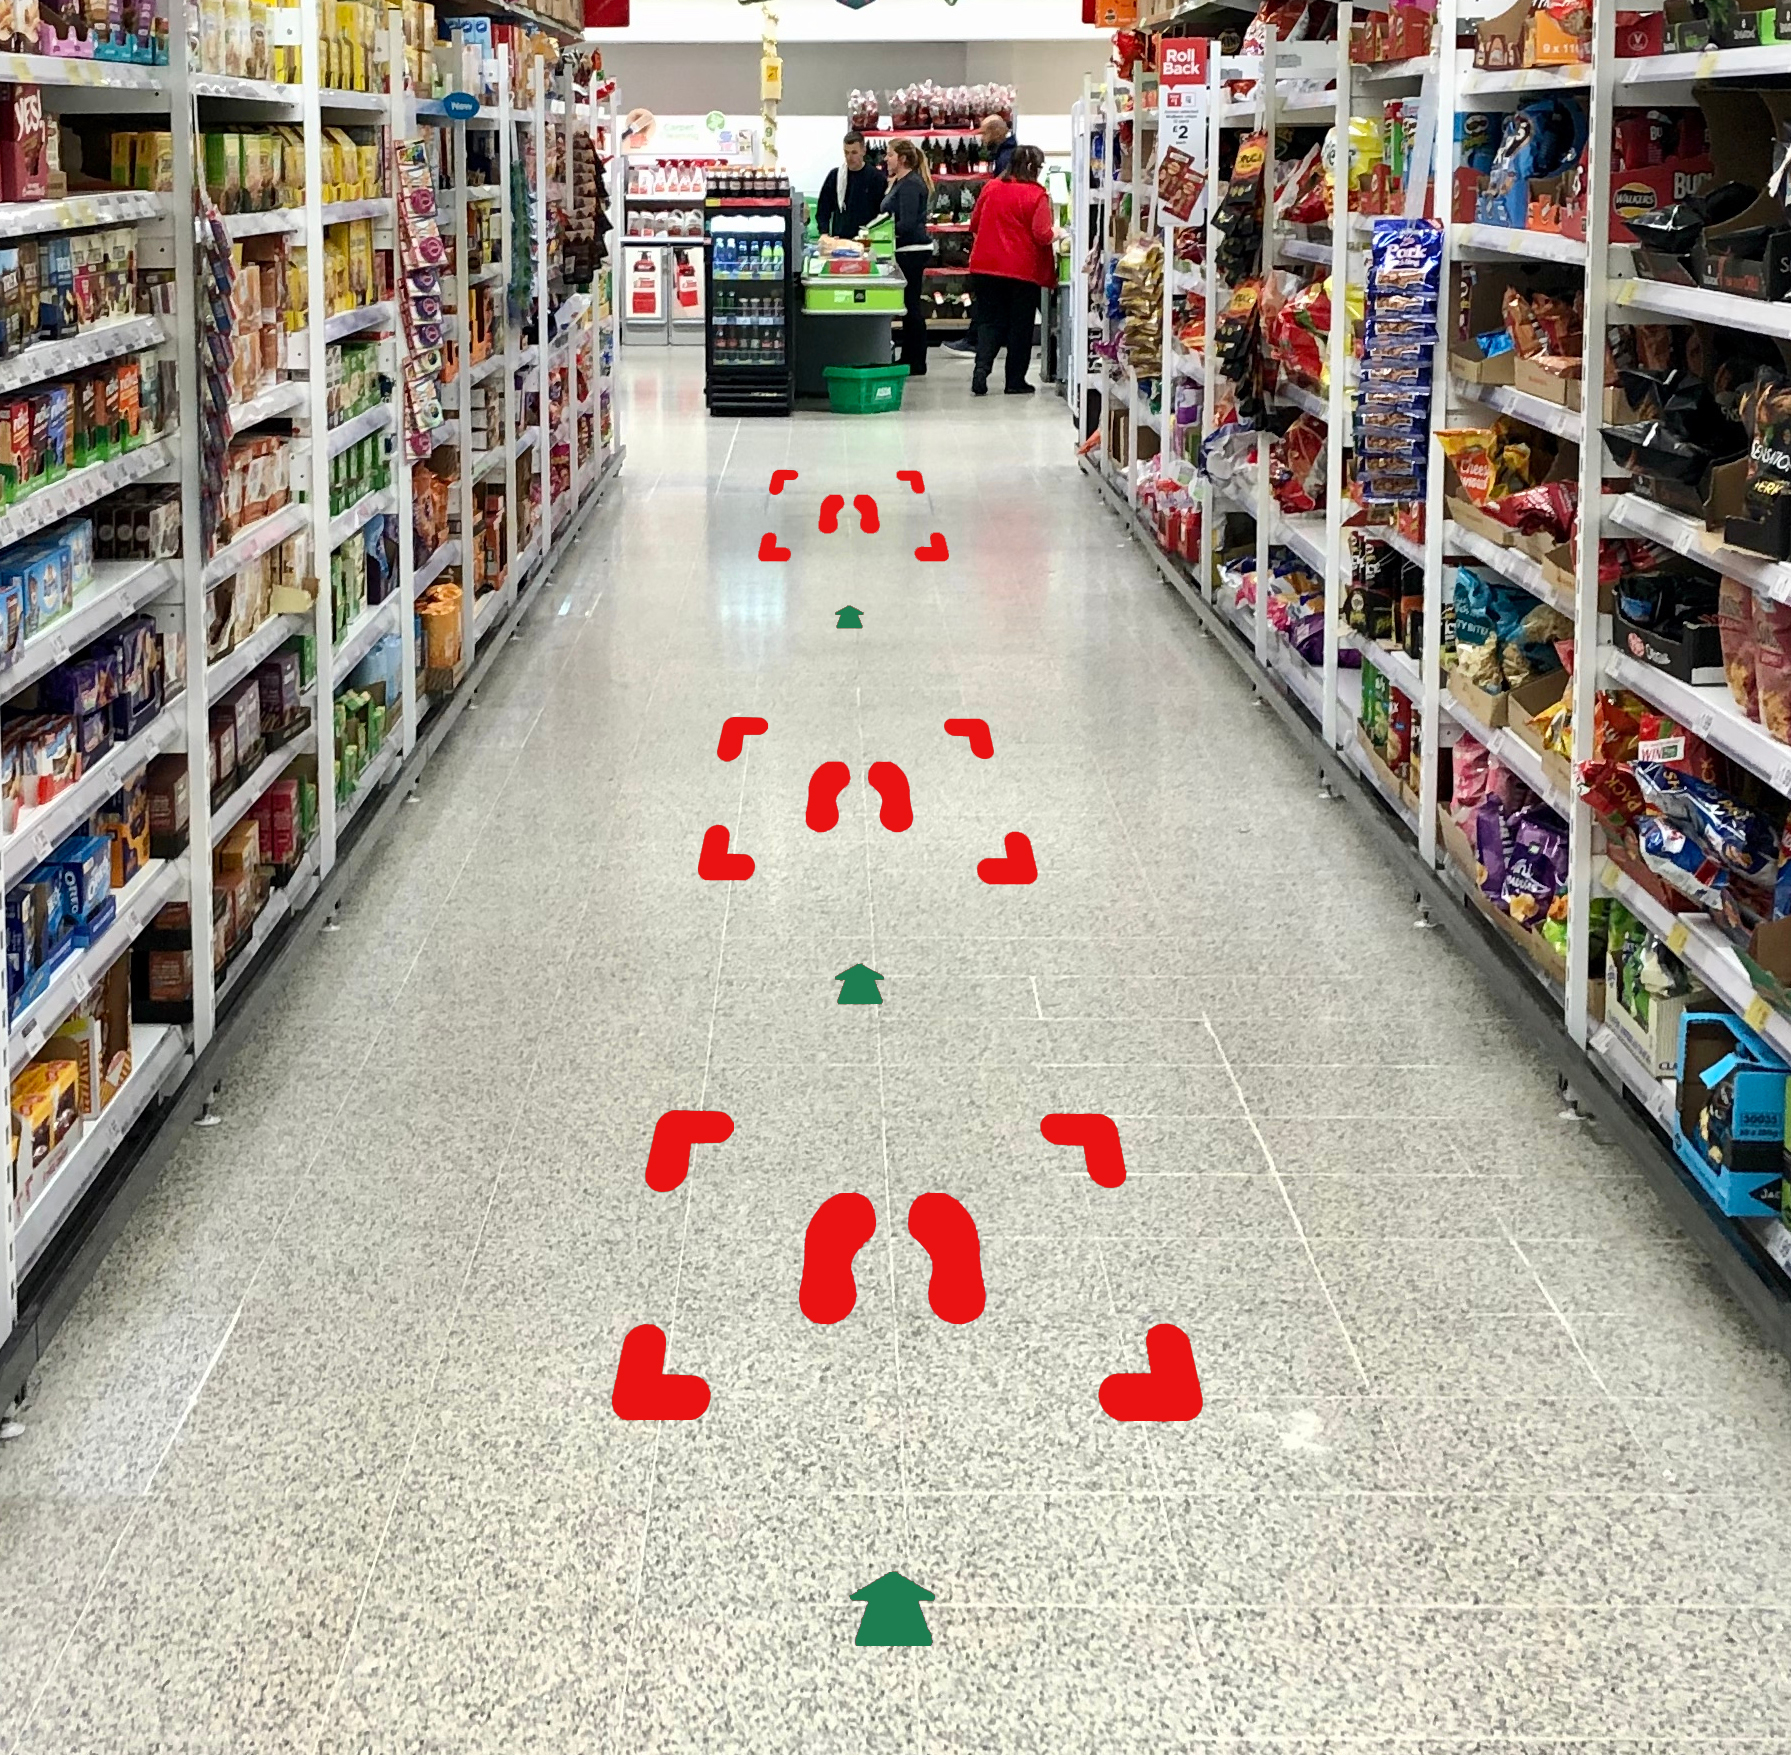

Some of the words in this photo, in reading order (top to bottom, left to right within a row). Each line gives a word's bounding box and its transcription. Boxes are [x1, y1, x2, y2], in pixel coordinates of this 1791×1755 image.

[1166, 48, 1195, 62] Roll
[1163, 62, 1200, 75] Back
[1172, 125, 1188, 139] £2
[1615, 193, 1655, 205] WALKERS
[1386, 243, 1428, 259] Pork
[1640, 747, 1663, 762] WIN
[1606, 774, 1642, 811] PACK
